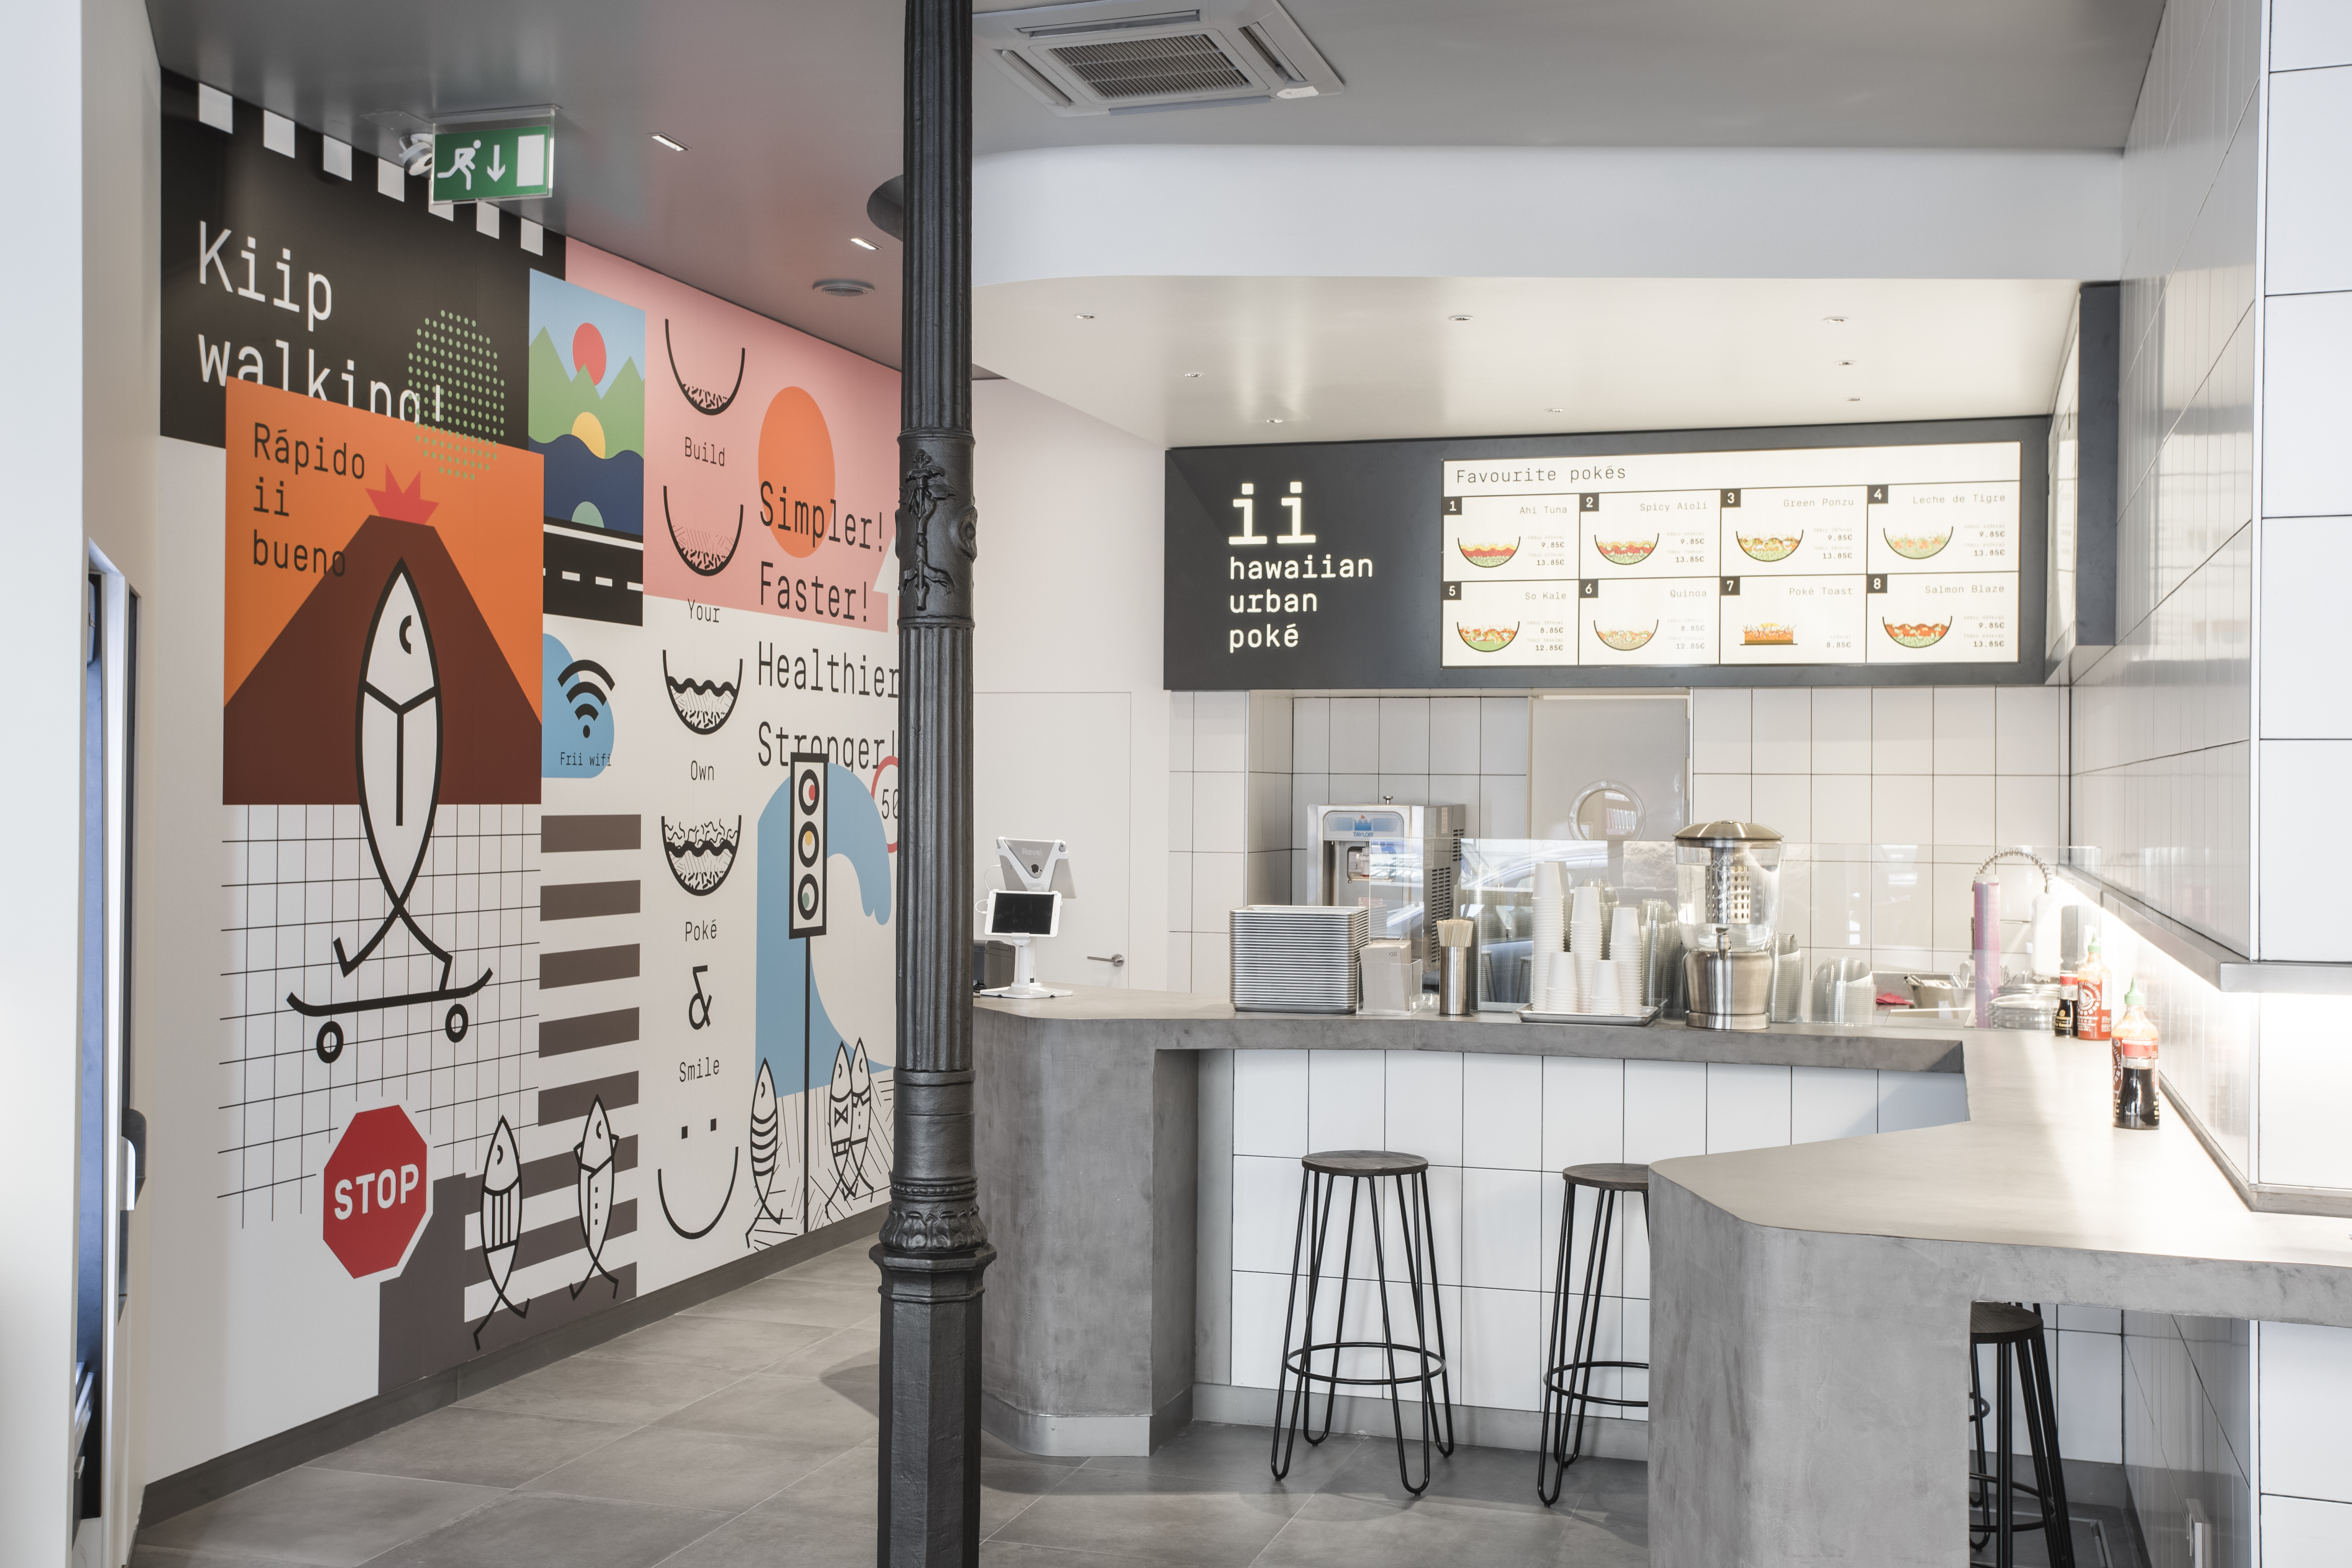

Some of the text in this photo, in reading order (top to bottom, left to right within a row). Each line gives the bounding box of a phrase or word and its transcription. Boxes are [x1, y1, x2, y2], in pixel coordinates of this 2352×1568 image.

[199, 221, 332, 332] Kiip
[255, 422, 365, 479] Rápido
[685, 437, 725, 466] Build
[1457, 465, 1625, 483] Favourite pokés
[254, 477, 289, 517] ii
[1586, 496, 1593, 508] 2
[1727, 492, 1734, 504] 3
[1783, 498, 1854, 507] Green Ponzu
[1874, 489, 1882, 500] 4
[1913, 494, 2005, 504] Leche de Tigre
[1229, 482, 1316, 545] ii
[1449, 501, 1456, 511] 1
[1640, 501, 1707, 512] Spicy Aioli
[760, 481, 883, 553] Simpler!
[253, 529, 345, 577] bueno
[1230, 554, 1372, 579] hawaiian
[761, 561, 867, 622] Faster!
[1449, 585, 1456, 596] 5
[1585, 583, 1592, 594] 6
[1727, 580, 1734, 591] 7
[1789, 587, 1852, 596] Poké Toast
[1873, 578, 1881, 589] 8
[1925, 584, 2004, 594] Salmon Blaze
[1230, 589, 1316, 613] urban
[1525, 591, 1566, 600] So Kale
[1670, 589, 1706, 598] Quinoa
[687, 598, 720, 623] Your
[1230, 624, 1298, 653] poké
[560, 752, 611, 766] Frii wifi
[691, 760, 714, 781] Own
[1022, 848, 1043, 856] Revel
[686, 919, 716, 941] Poké
[679, 1057, 719, 1082] Smile
[334, 1164, 419, 1220] STOP
